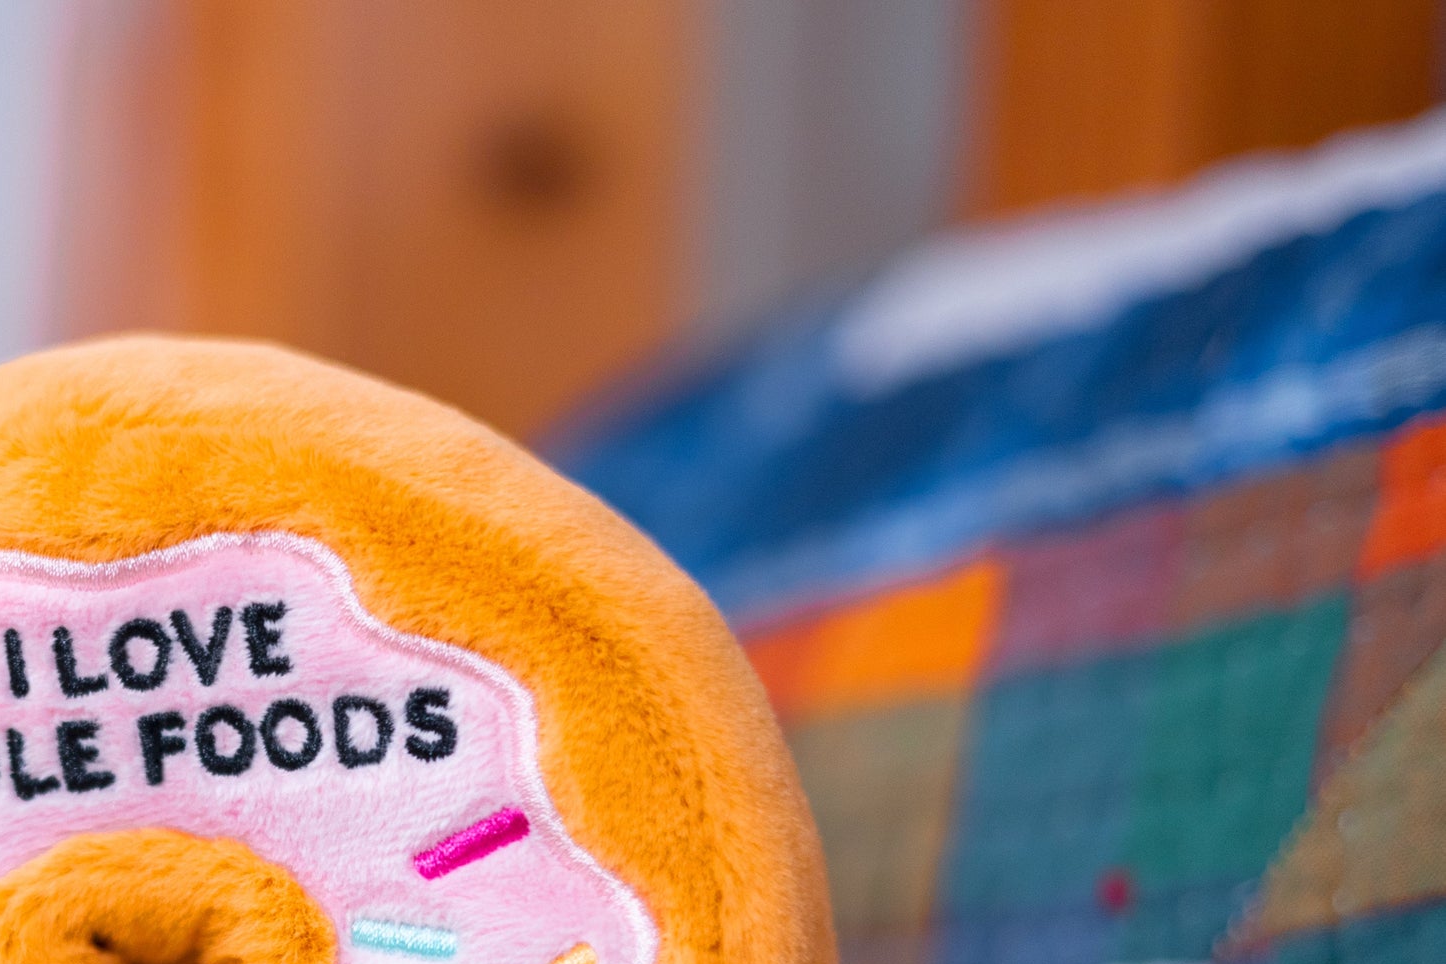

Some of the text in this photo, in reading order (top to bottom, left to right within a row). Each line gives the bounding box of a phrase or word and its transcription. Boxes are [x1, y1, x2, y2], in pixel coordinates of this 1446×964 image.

[3, 601, 294, 699] I LOVE
[137, 686, 458, 787] FOODS
